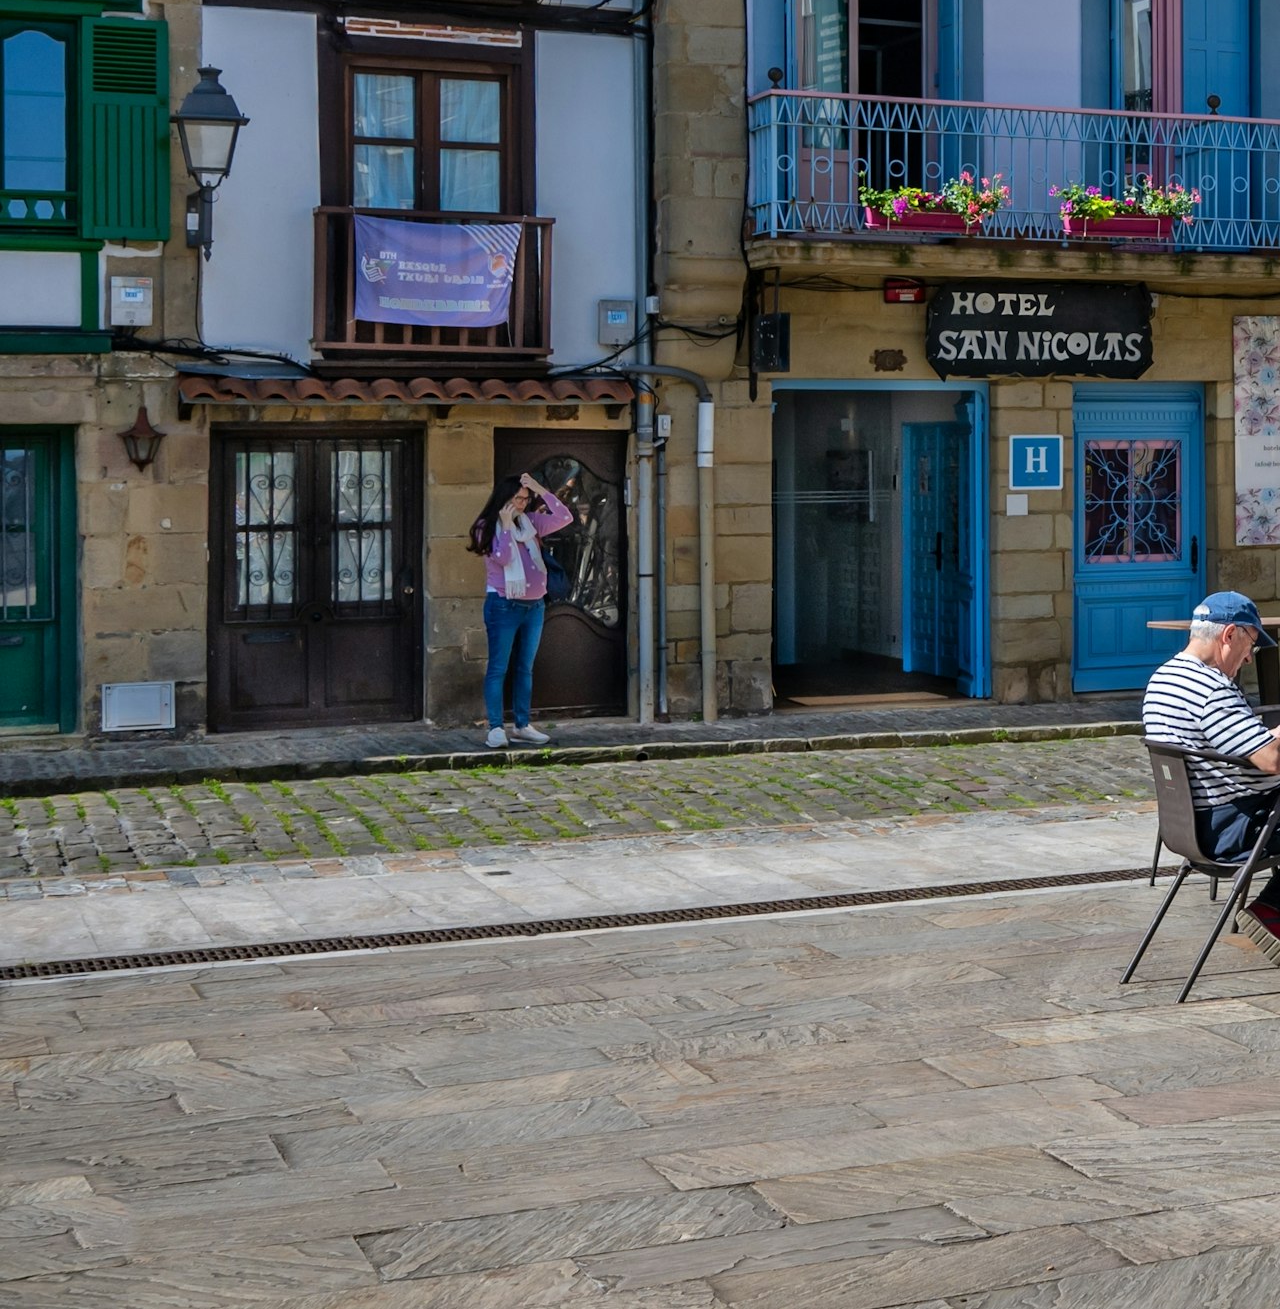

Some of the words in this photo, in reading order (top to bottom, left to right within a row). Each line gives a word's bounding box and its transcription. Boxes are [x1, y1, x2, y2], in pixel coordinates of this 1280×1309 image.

[950, 291, 1056, 317] HOTEL
[937, 330, 1009, 360] SAN
[1024, 446, 1049, 473] H
